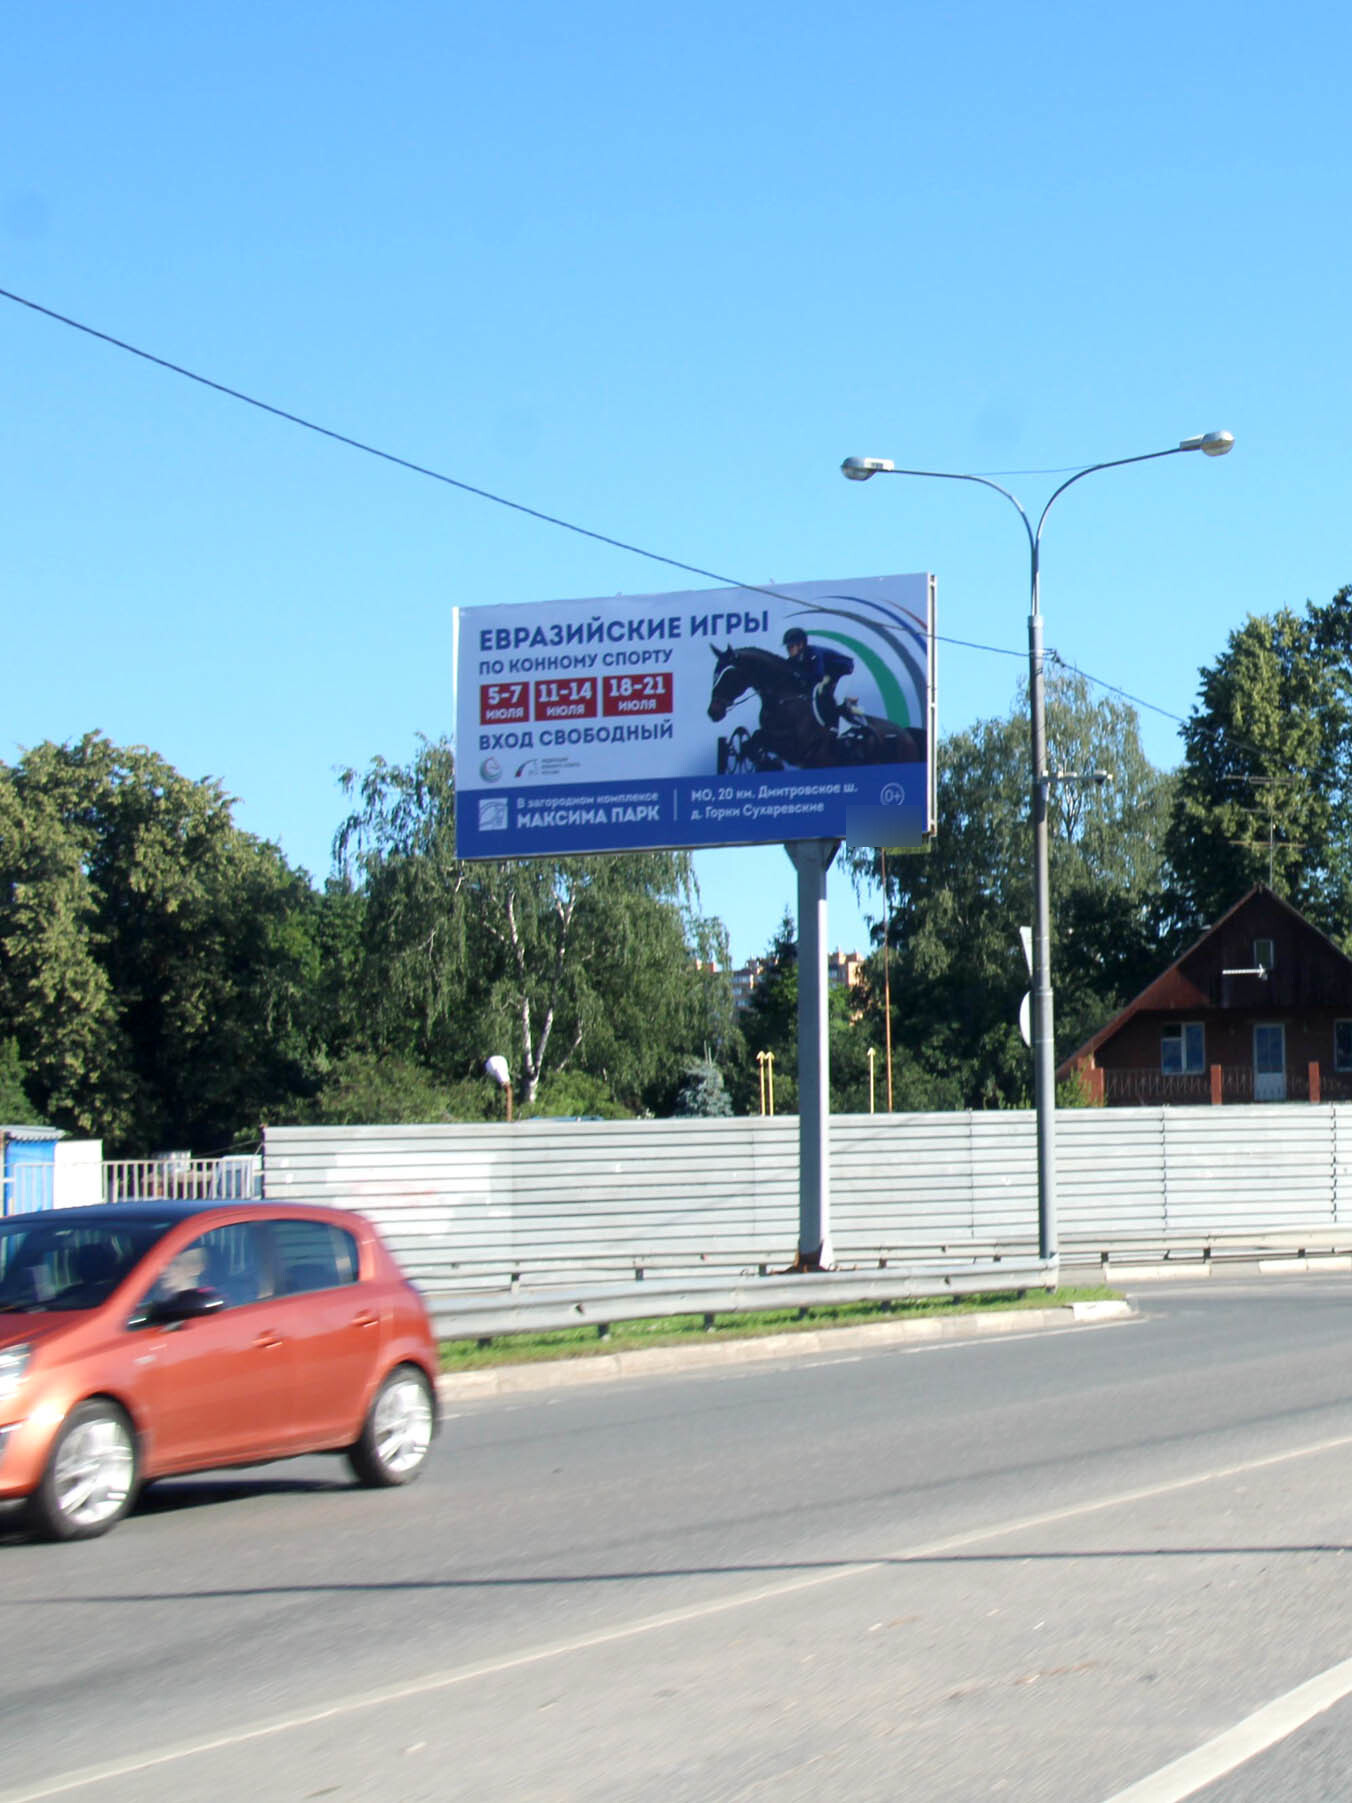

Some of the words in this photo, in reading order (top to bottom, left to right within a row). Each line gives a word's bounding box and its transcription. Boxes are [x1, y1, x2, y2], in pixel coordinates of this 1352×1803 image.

[480, 616, 681, 651] ЕВРАЗИЙСКИЕ
[691, 611, 768, 637] ИГРЫ
[479, 661, 504, 675] ПО
[509, 654, 597, 673] КОННОМУ
[603, 649, 673, 666] СПОРТУ
[488, 686, 522, 705] 5-7
[539, 682, 593, 702] 11-14
[609, 676, 666, 697] 18-21
[479, 731, 534, 750] ВХОД
[539, 719, 673, 746] СВОБОДНЫЙ
[527, 796, 594, 810] загородном
[597, 792, 659, 805] комплексе
[691, 788, 715, 802] МО,
[718, 787, 733, 800] 20
[758, 784, 840, 801] Дмитровское
[843, 783, 858, 794] ш.
[884, 789, 901, 803] 0+
[517, 808, 607, 829] МАКСИМА
[612, 806, 660, 824] ПАРК
[705, 806, 740, 821] Горки
[742, 803, 824, 820] Сухаревские
